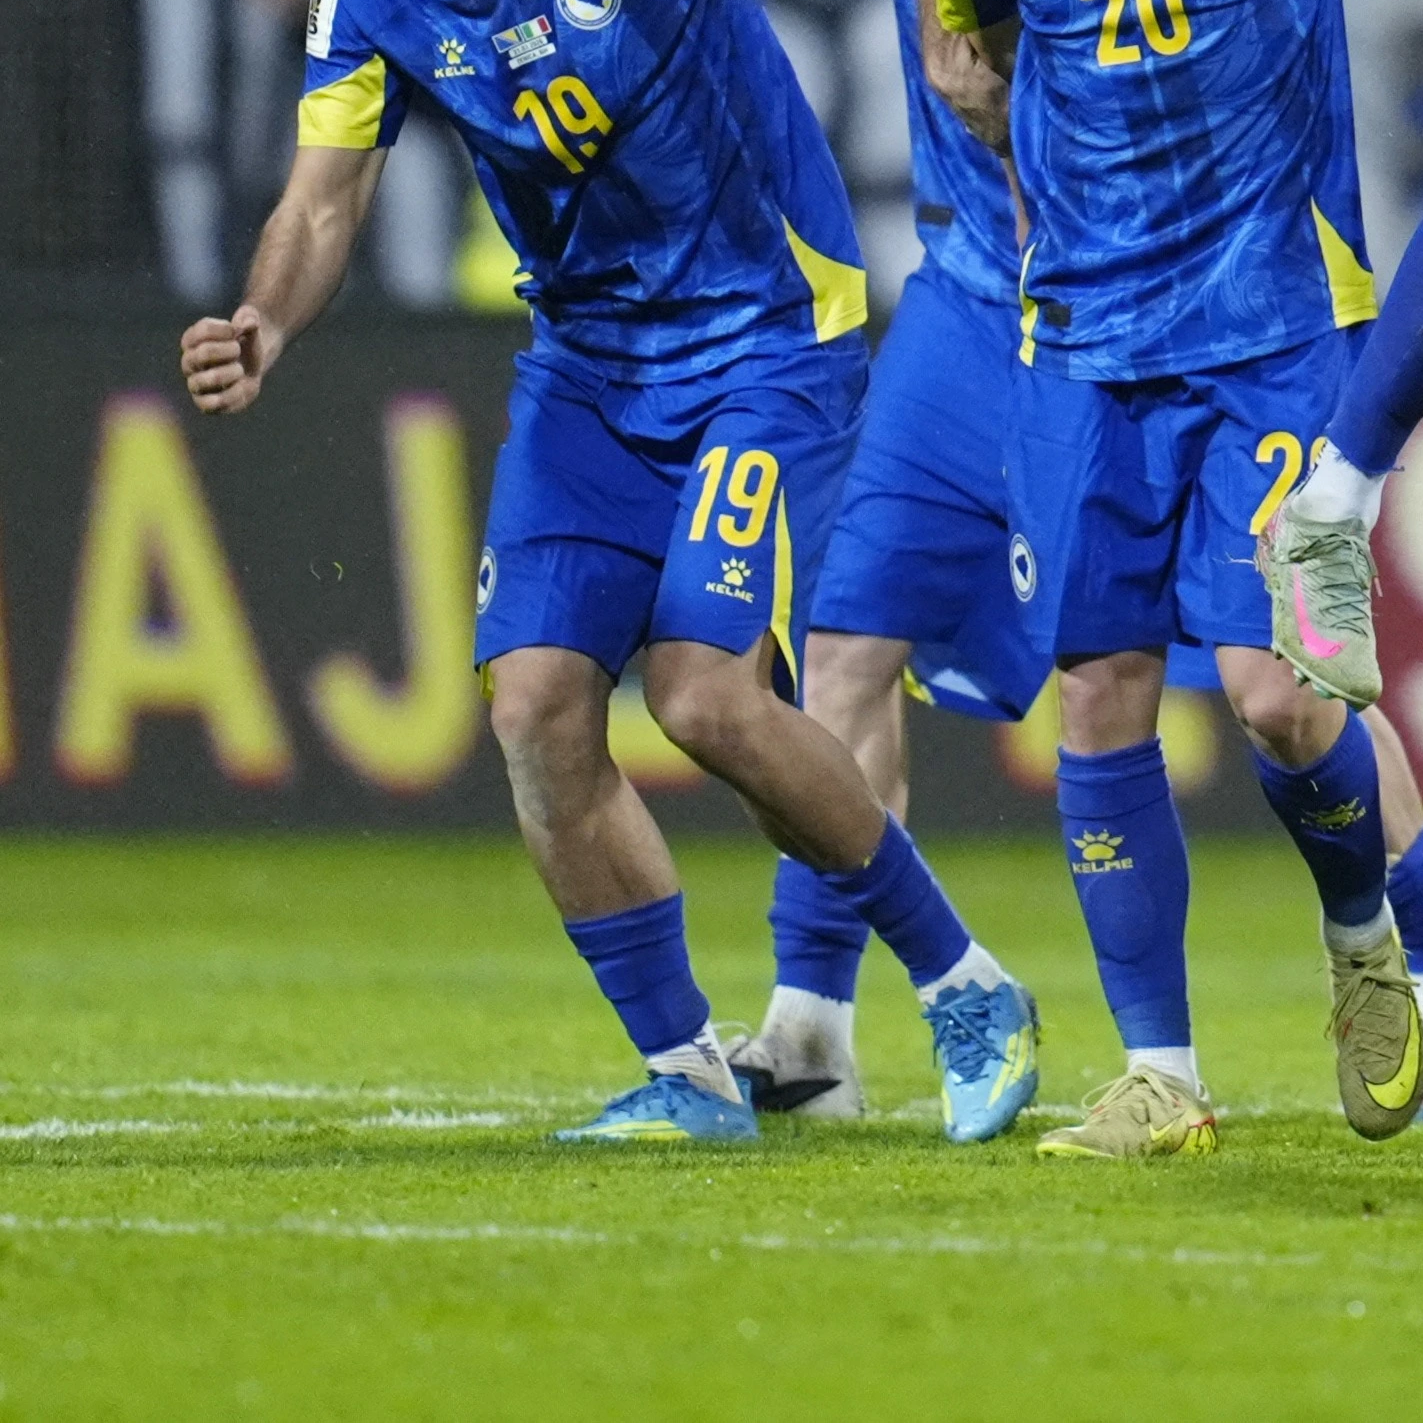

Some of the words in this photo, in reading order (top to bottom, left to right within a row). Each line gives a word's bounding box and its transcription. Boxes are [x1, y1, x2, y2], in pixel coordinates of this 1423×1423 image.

[434, 66, 476, 79] KELME
[513, 75, 614, 174] 19
[688, 445, 780, 547] 19
[1249, 430, 1328, 536] 2
[705, 581, 755, 604] KELME
[1071, 857, 1134, 874] KELME
